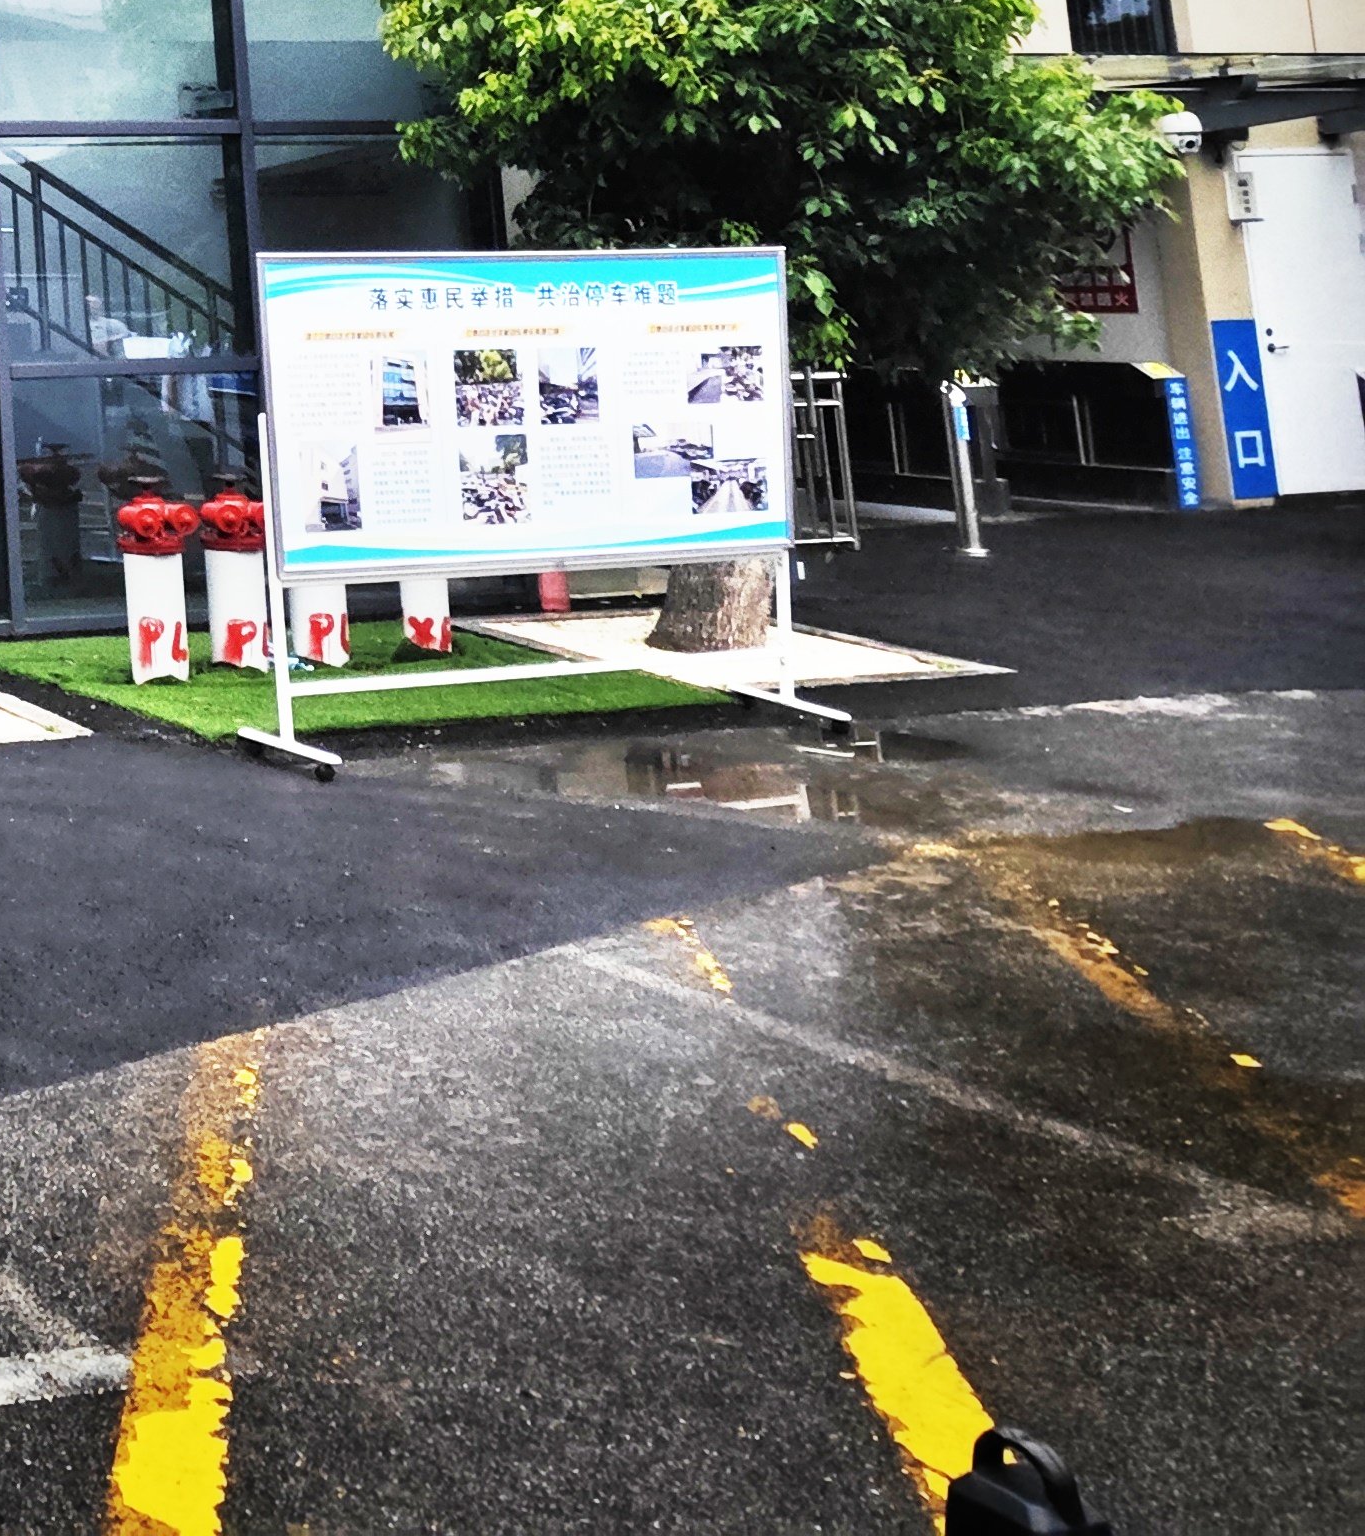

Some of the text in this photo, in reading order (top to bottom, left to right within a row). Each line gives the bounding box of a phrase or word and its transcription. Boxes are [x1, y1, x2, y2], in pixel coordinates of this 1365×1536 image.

[369, 283, 677, 310] 落实惠民举措 共治停车难题
[1224, 350, 1267, 469] 入口
